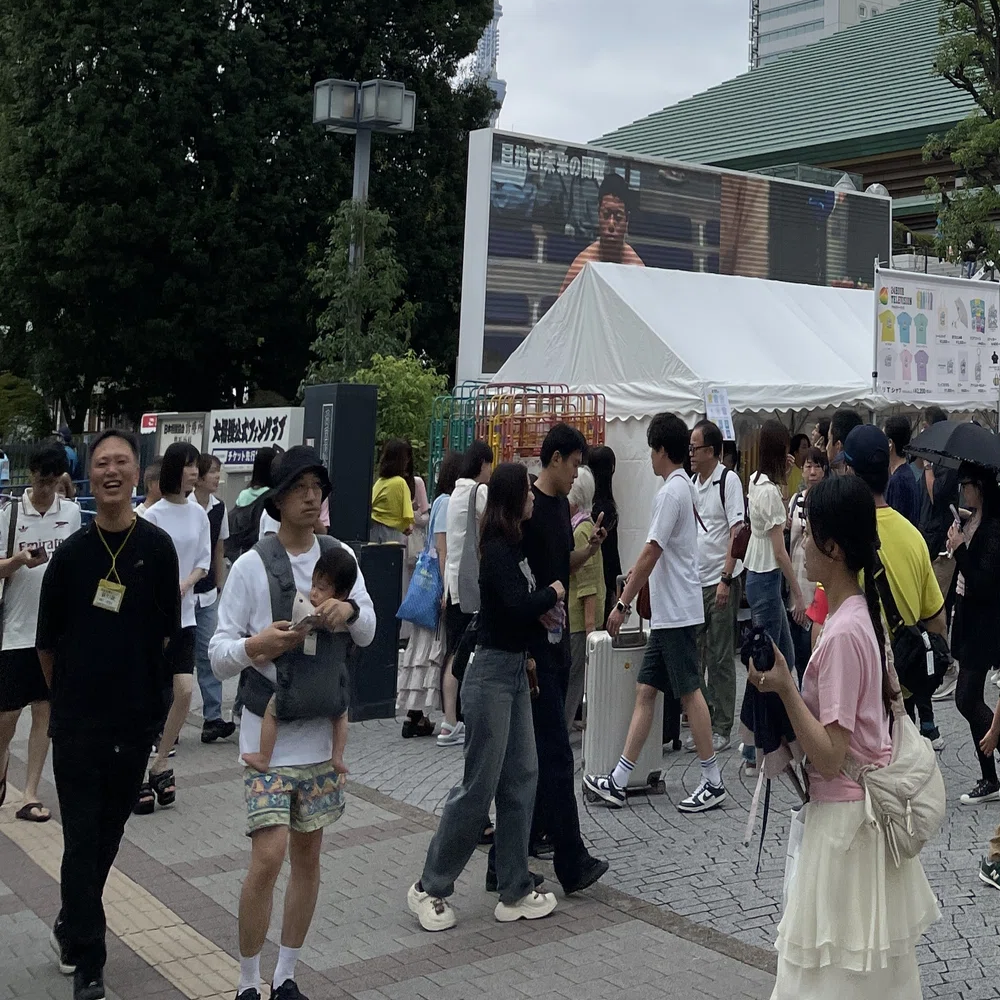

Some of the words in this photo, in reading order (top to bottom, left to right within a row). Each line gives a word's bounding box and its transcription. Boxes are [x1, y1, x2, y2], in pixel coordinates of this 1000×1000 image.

[228, 450, 257, 462] チケット先行
